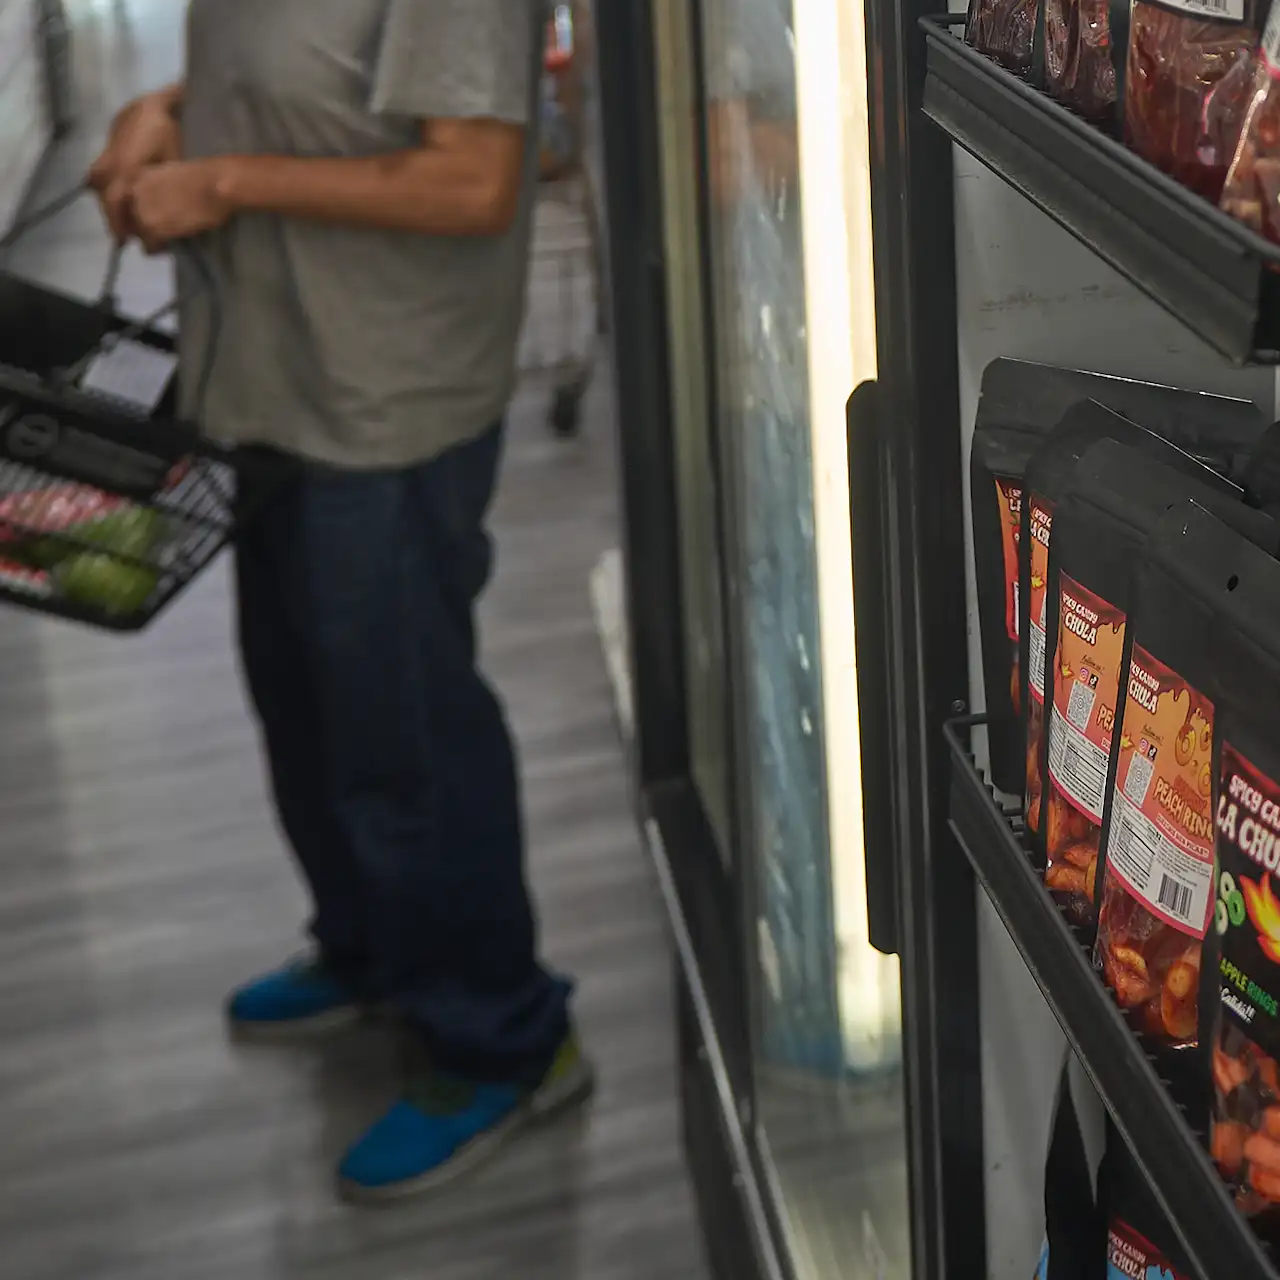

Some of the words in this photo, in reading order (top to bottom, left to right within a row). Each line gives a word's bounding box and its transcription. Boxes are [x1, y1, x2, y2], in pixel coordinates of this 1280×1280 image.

[1065, 611, 1097, 645] CHULA
[1129, 679, 1158, 714] CHULA
[1154, 777, 1185, 825] PEACH
[1229, 773, 1261, 815] SPICY
[1216, 793, 1238, 840] LA
[1220, 958, 1248, 993] APPLE
[1112, 1251, 1147, 1280] CHULA
